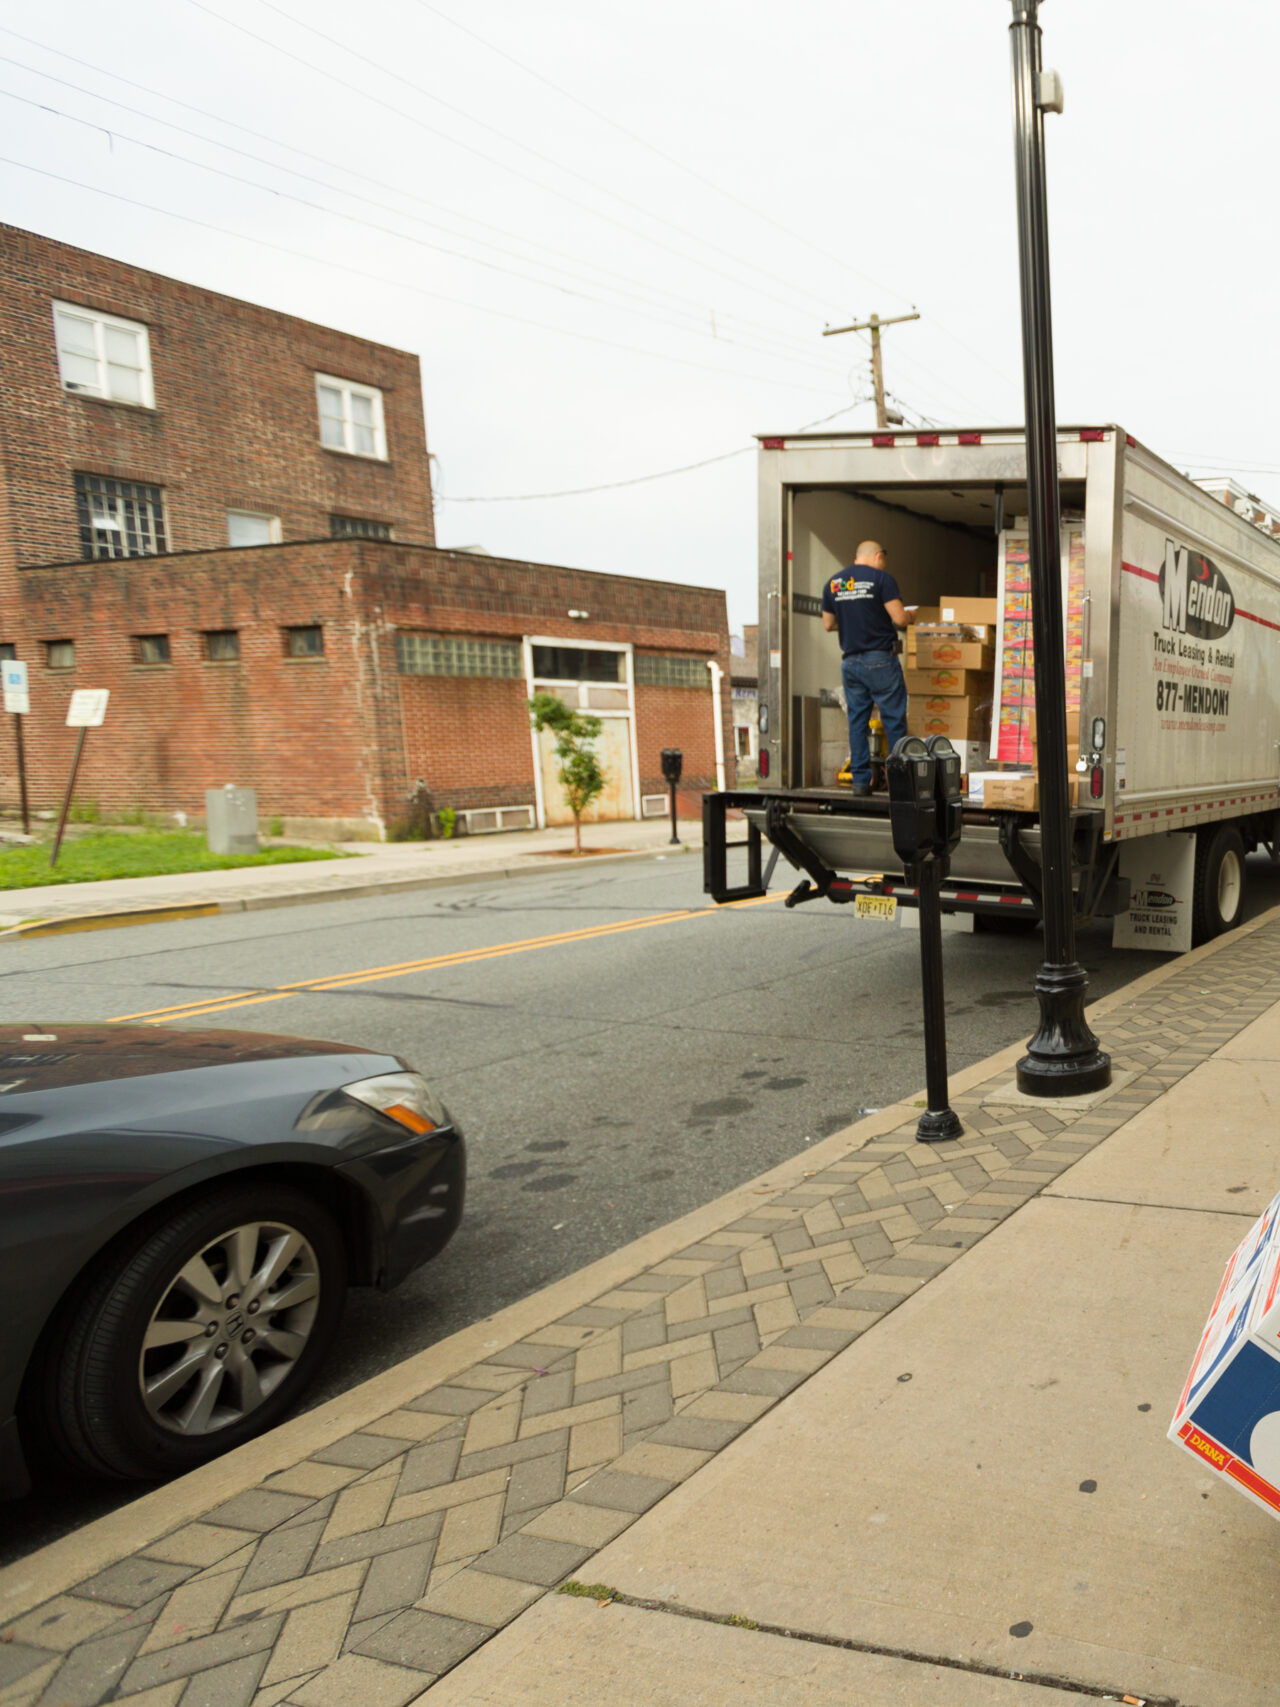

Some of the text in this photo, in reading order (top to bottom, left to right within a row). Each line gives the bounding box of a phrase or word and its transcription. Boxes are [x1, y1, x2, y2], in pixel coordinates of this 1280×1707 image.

[1163, 538, 1232, 634] Mendon
[1153, 632, 1235, 668] Truck Leasing & Rental
[1157, 680, 1229, 716] 877-MENDON1
[1190, 1433, 1225, 1466] DIANA
